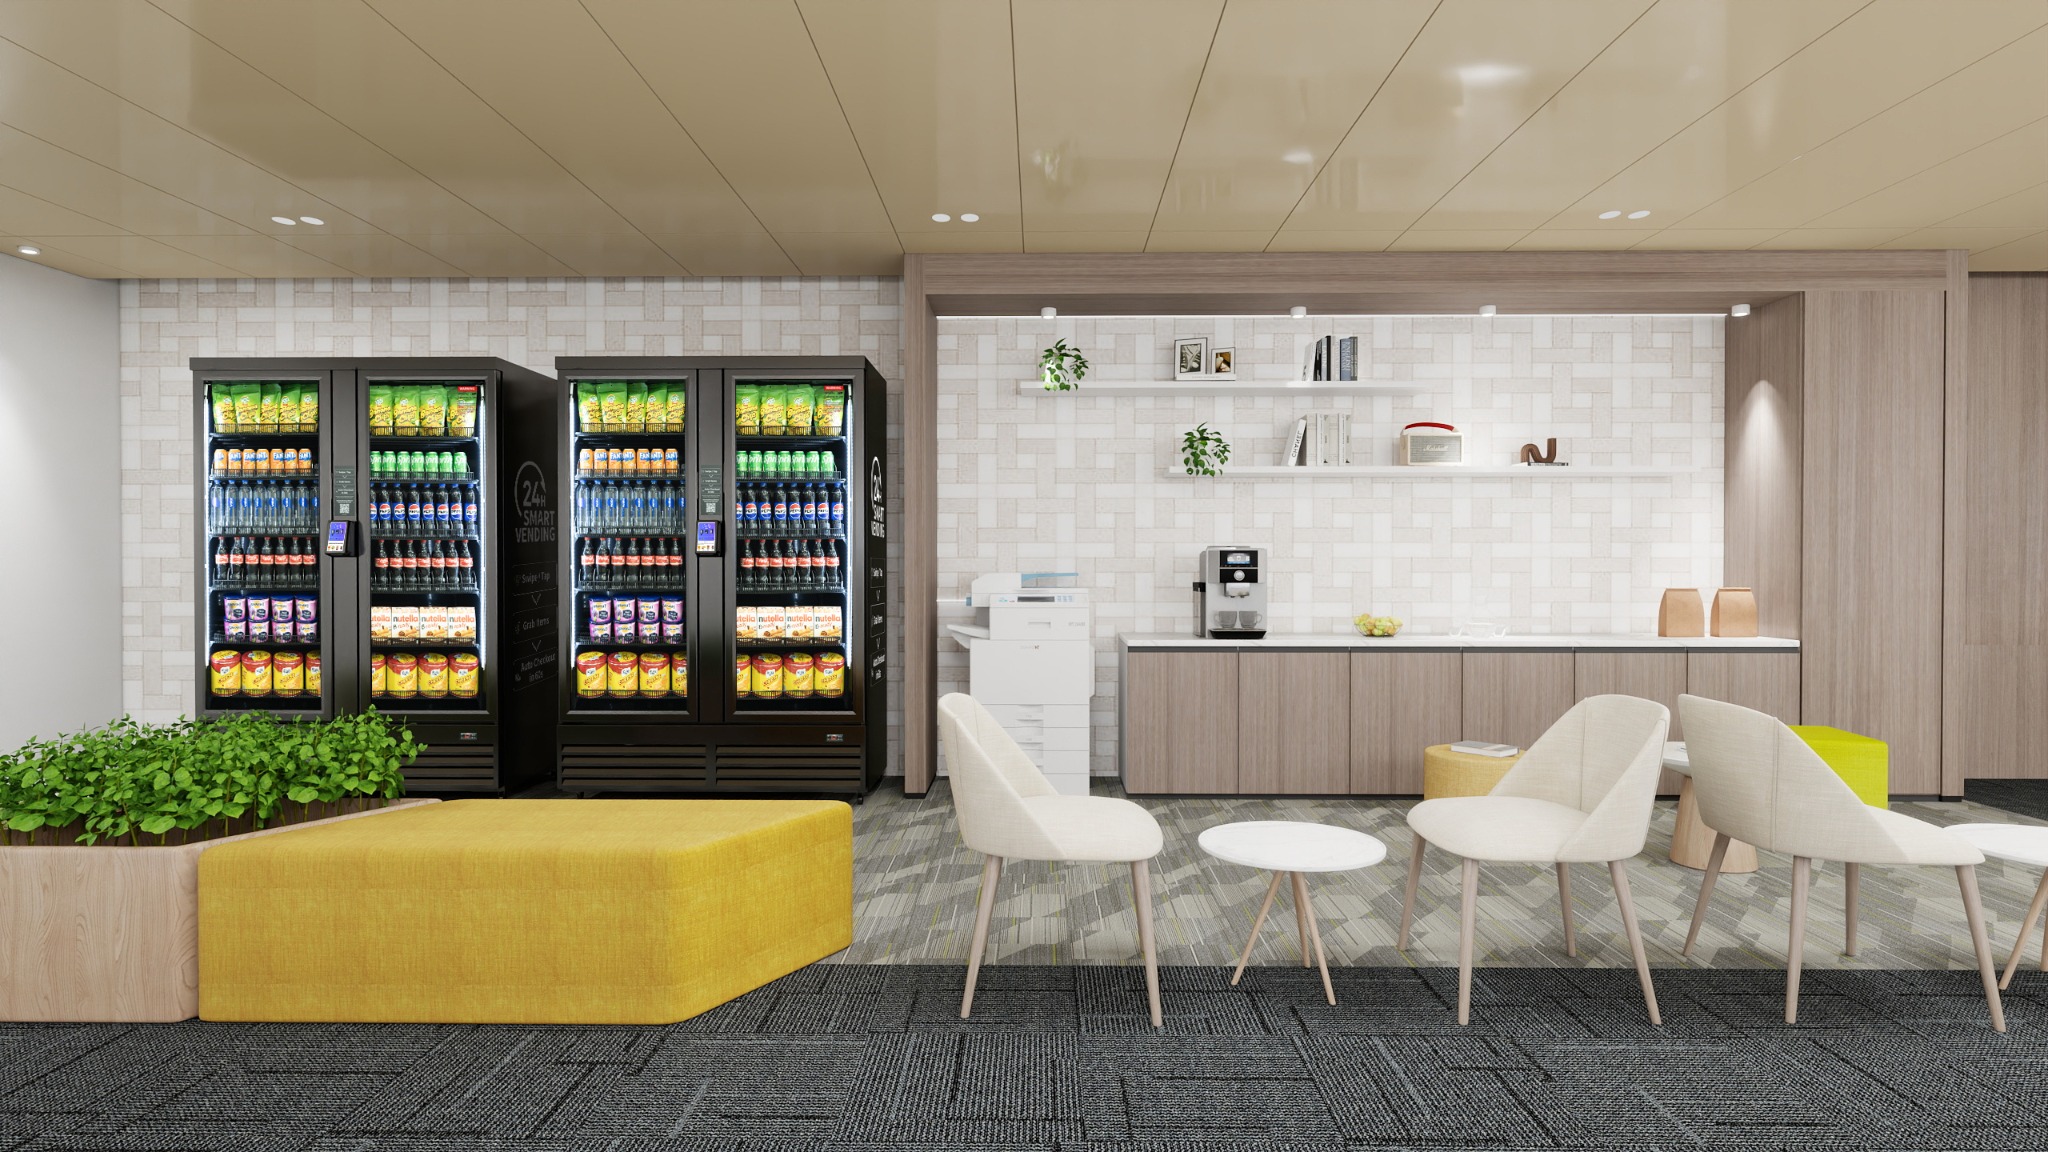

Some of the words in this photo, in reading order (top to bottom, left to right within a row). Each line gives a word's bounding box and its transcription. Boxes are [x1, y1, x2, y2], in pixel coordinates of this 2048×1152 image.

[523, 510, 555, 526] SMART
[515, 527, 556, 543] VENDING
[541, 571, 551, 582] Tap
[523, 619, 535, 630] Grab
